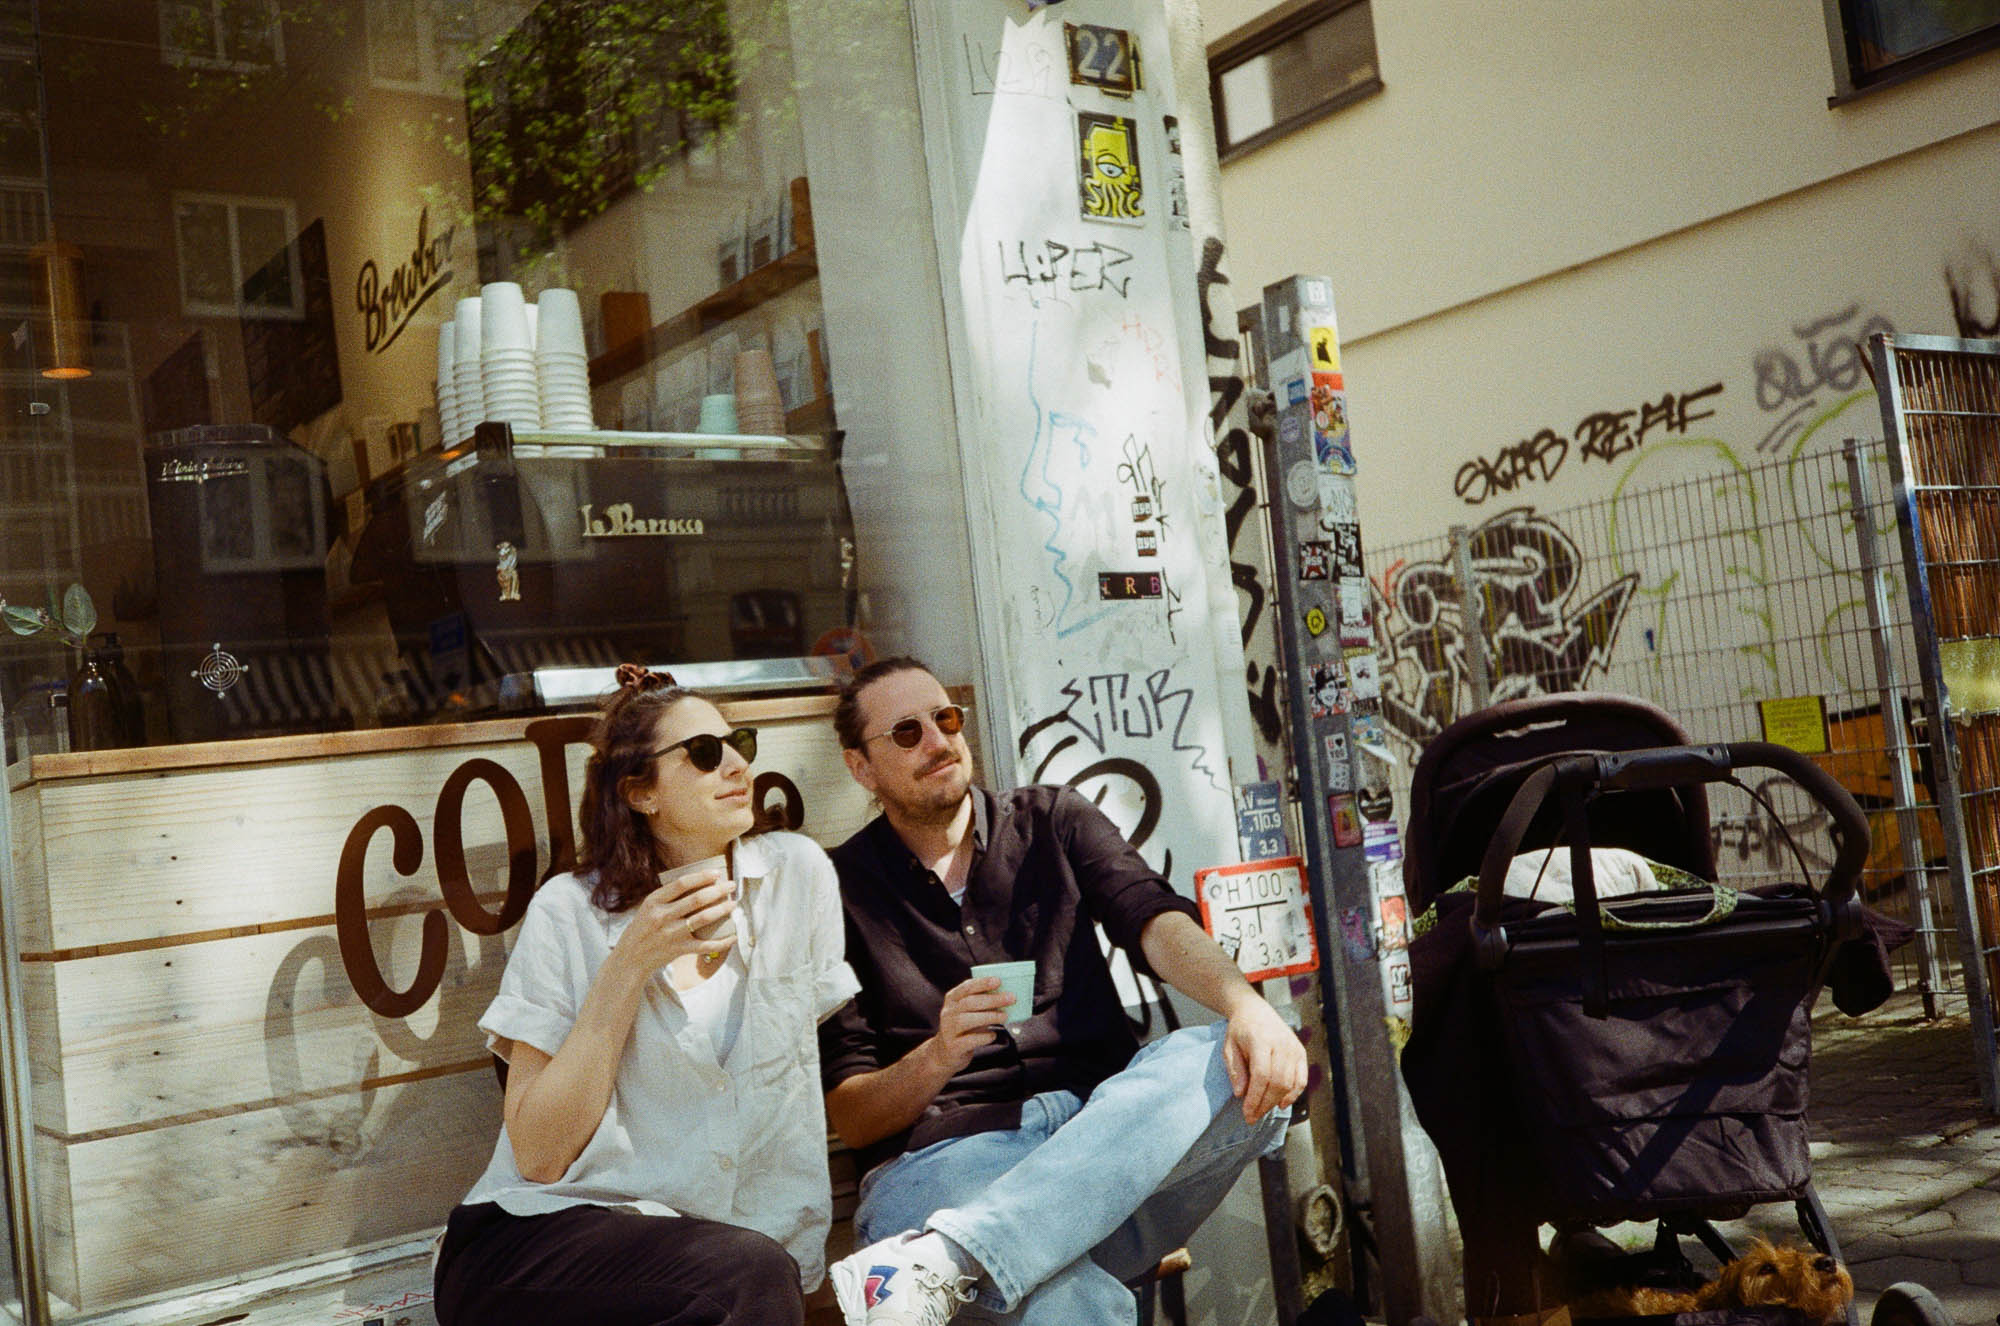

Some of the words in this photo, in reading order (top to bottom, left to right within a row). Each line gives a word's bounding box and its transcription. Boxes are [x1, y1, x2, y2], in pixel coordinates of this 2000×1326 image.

[1074, 29, 1127, 82] 22
[1262, 812, 1282, 830] 0.9
[1258, 837, 1279, 856] 3.3
